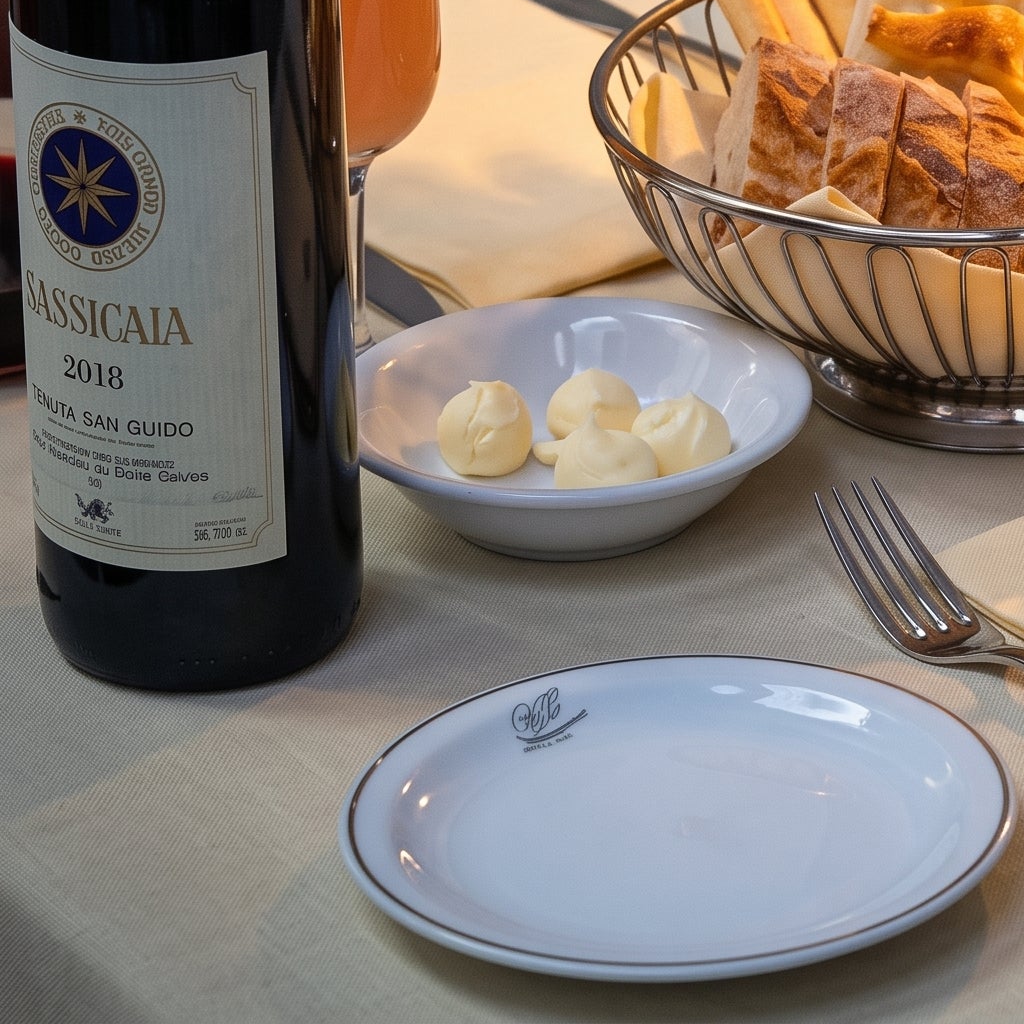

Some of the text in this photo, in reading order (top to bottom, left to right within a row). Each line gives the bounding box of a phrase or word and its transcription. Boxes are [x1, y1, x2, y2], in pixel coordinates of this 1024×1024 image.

[26, 269, 193, 346] SASSICAIA
[63, 354, 124, 390] 2018
[31, 382, 77, 423] TENUTA
[83, 411, 119, 433] SAN
[127, 419, 194, 438] GUIDO
